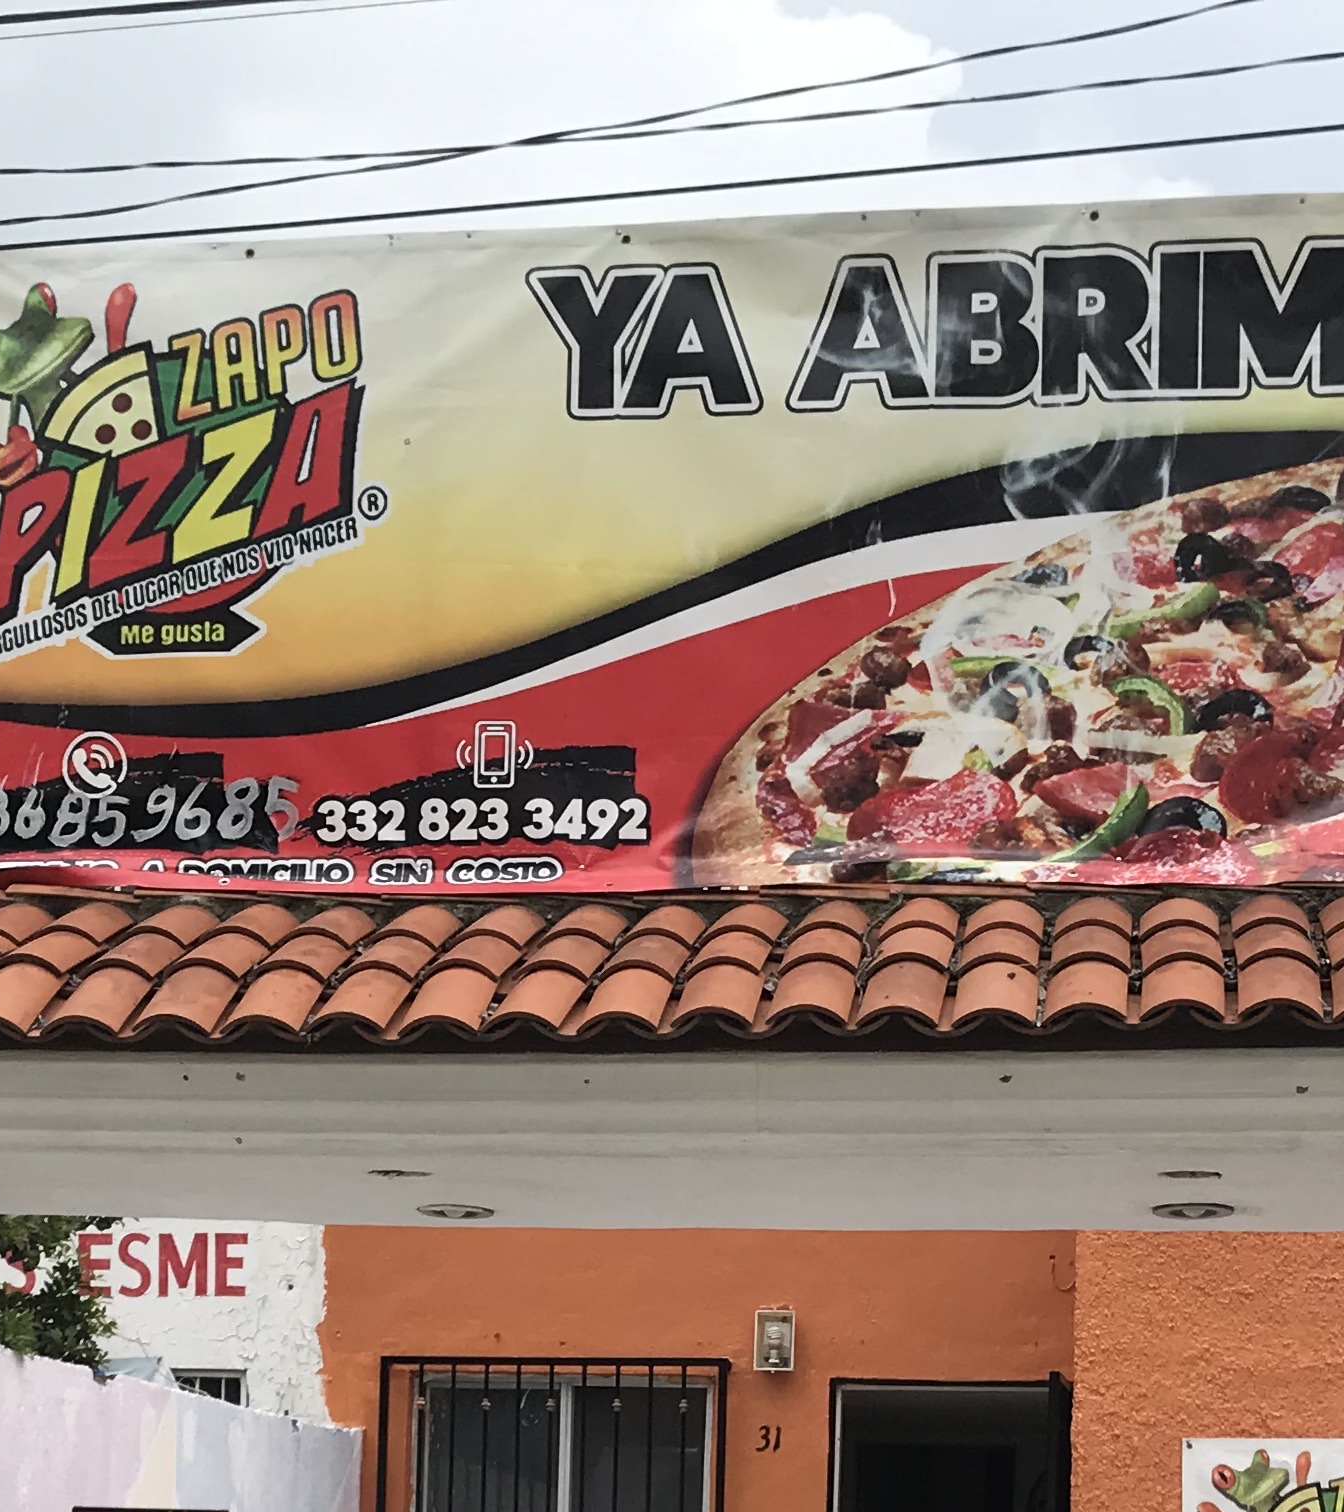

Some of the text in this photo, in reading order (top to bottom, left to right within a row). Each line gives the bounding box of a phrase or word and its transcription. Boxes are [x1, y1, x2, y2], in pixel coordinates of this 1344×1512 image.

[168, 289, 364, 421] ZAPO
[528, 264, 763, 418] YA
[91, 594, 122, 623] DEL
[124, 573, 182, 611] LUGAR
[184, 561, 219, 592] QUE
[223, 550, 261, 583] NOS
[263, 535, 296, 566] VIO
[297, 517, 358, 558] NACER
[120, 621, 225, 648] Me gusta
[317, 797, 648, 842] 332 823 3492
[372, 860, 433, 884] SIN
[448, 858, 562, 884] COSTO
[756, 1425, 782, 1452] 31
